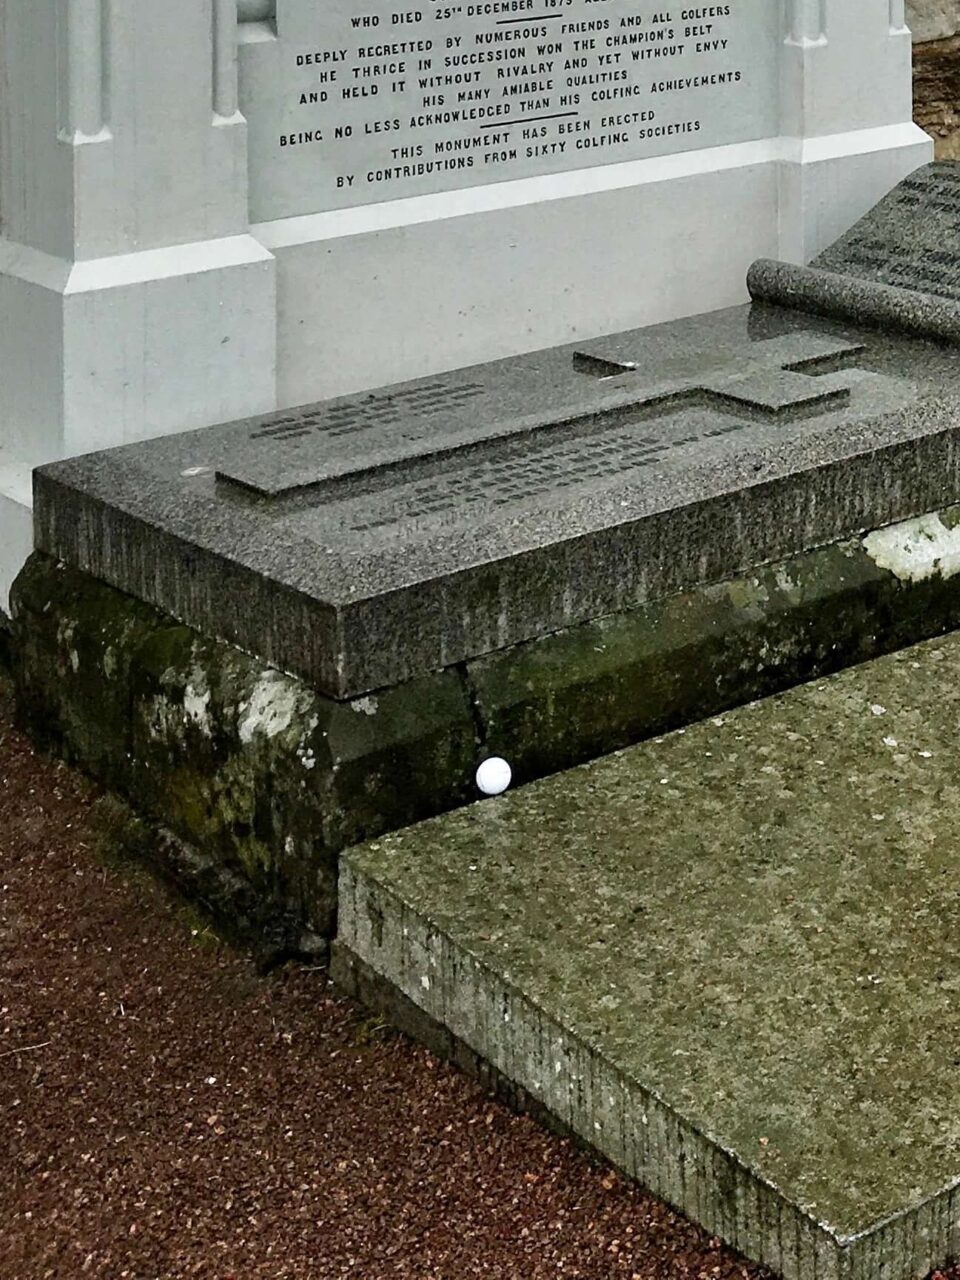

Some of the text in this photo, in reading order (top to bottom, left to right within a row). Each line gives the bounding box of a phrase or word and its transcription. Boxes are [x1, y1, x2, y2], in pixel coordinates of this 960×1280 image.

[351, 15, 380, 28] WHO
[391, 11, 422, 25] DIED
[467, 0, 533, 17] DECEMBER
[296, 49, 348, 66] DEEPLY
[475, 26, 547, 45] NUMEROUS
[561, 19, 609, 34] FRIENDS
[351, 24, 713, 79] THRICE SUCCESSION WON CHAMPION'S BELT
[342, 39, 728, 100] HELD WITHOUT RIVALRY YET WITHOUT ENVY
[458, 70, 627, 103] MANY AMIABLE QUALITIES
[365, 119, 400, 134] LESS
[519, 97, 550, 112] THAN
[650, 71, 741, 93] ACHIEVEMENTS
[367, 156, 474, 182] CONTRIBUTIONS
[484, 149, 517, 164] FROM
[526, 141, 566, 158] SIXTY
[639, 120, 700, 139] SOCIETIES
[390, 110, 655, 159] THIS MONUMENT BEEN ERECTED
